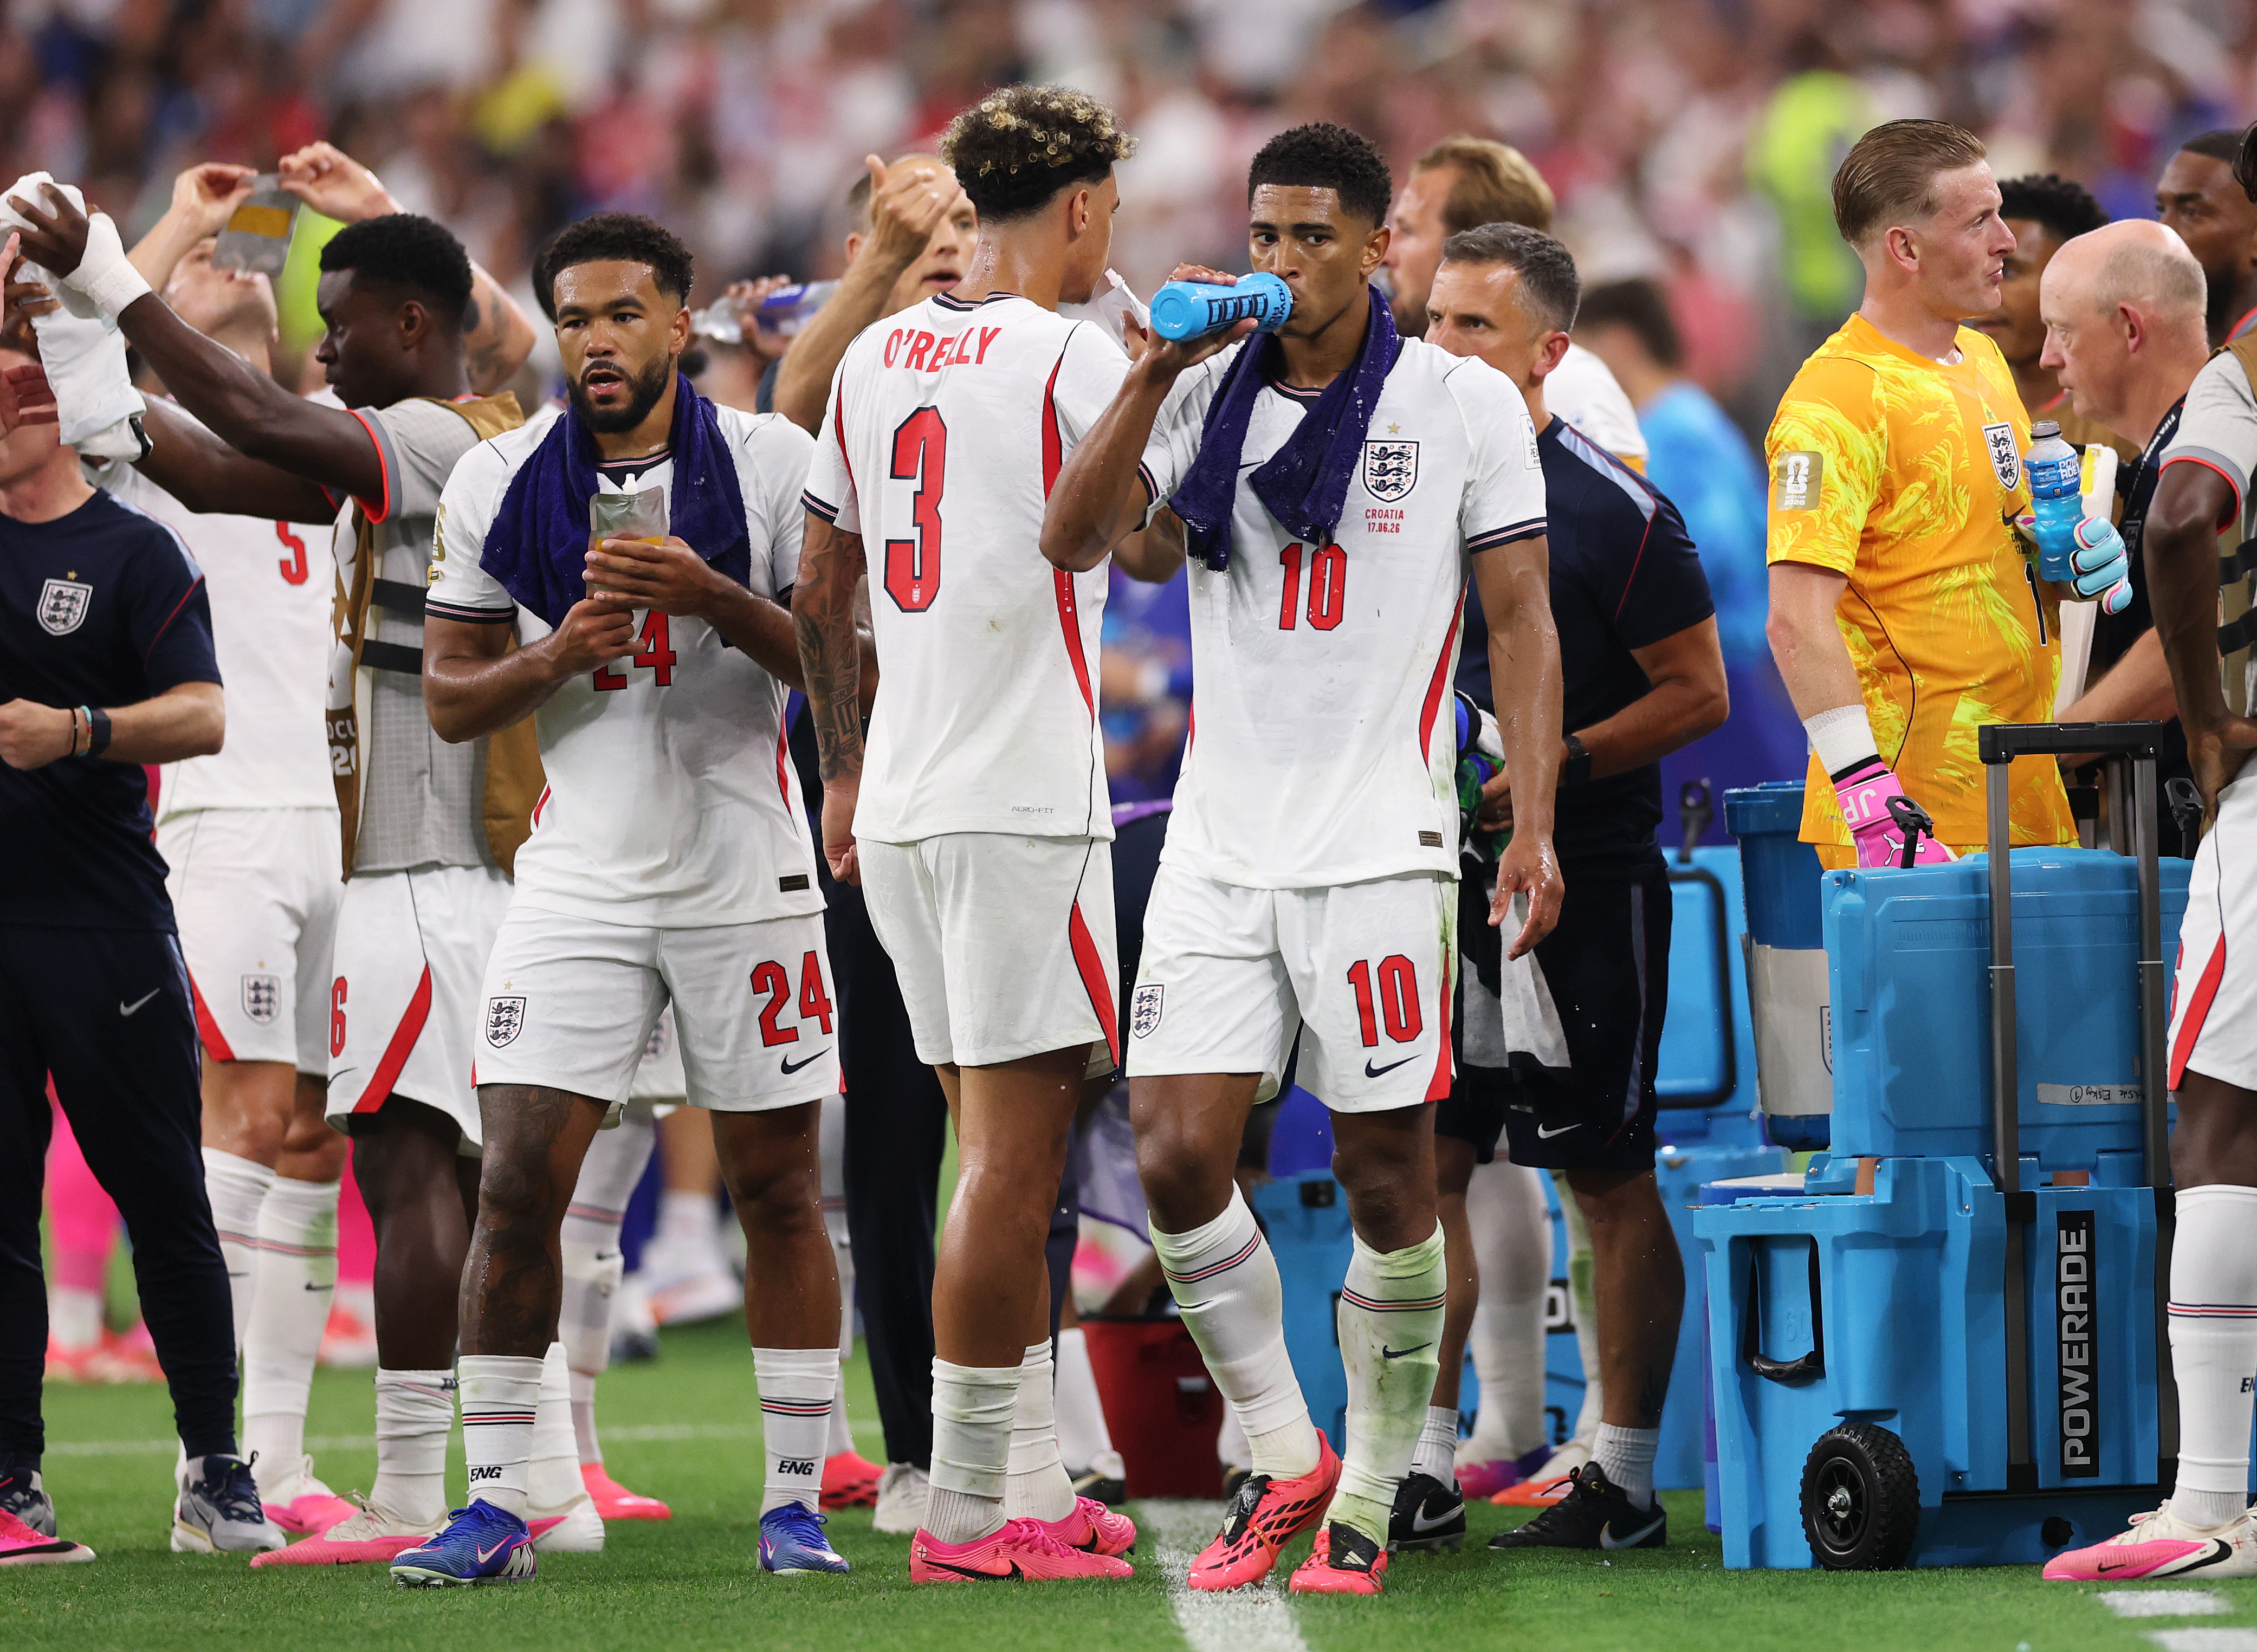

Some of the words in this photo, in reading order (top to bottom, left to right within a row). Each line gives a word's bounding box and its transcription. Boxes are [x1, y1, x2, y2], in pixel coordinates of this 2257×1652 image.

[884, 405, 947, 613] 3
[1366, 509, 1404, 520] CROATIA
[1368, 522, 1400, 533] 17.06.26
[277, 521, 308, 585] 5
[1279, 542, 1347, 631] 10
[2024, 561, 2047, 647] 1
[593, 608, 677, 692] 4
[1843, 789, 1877, 824] JP
[331, 976, 347, 1058] 6
[751, 951, 833, 1047] 24
[1347, 954, 1423, 1048] 10
[2060, 1229, 2090, 1465] POWERADE
[2240, 1377, 2255, 1392] EN
[470, 1466, 502, 1482] ENG
[778, 1460, 814, 1475] ENG
